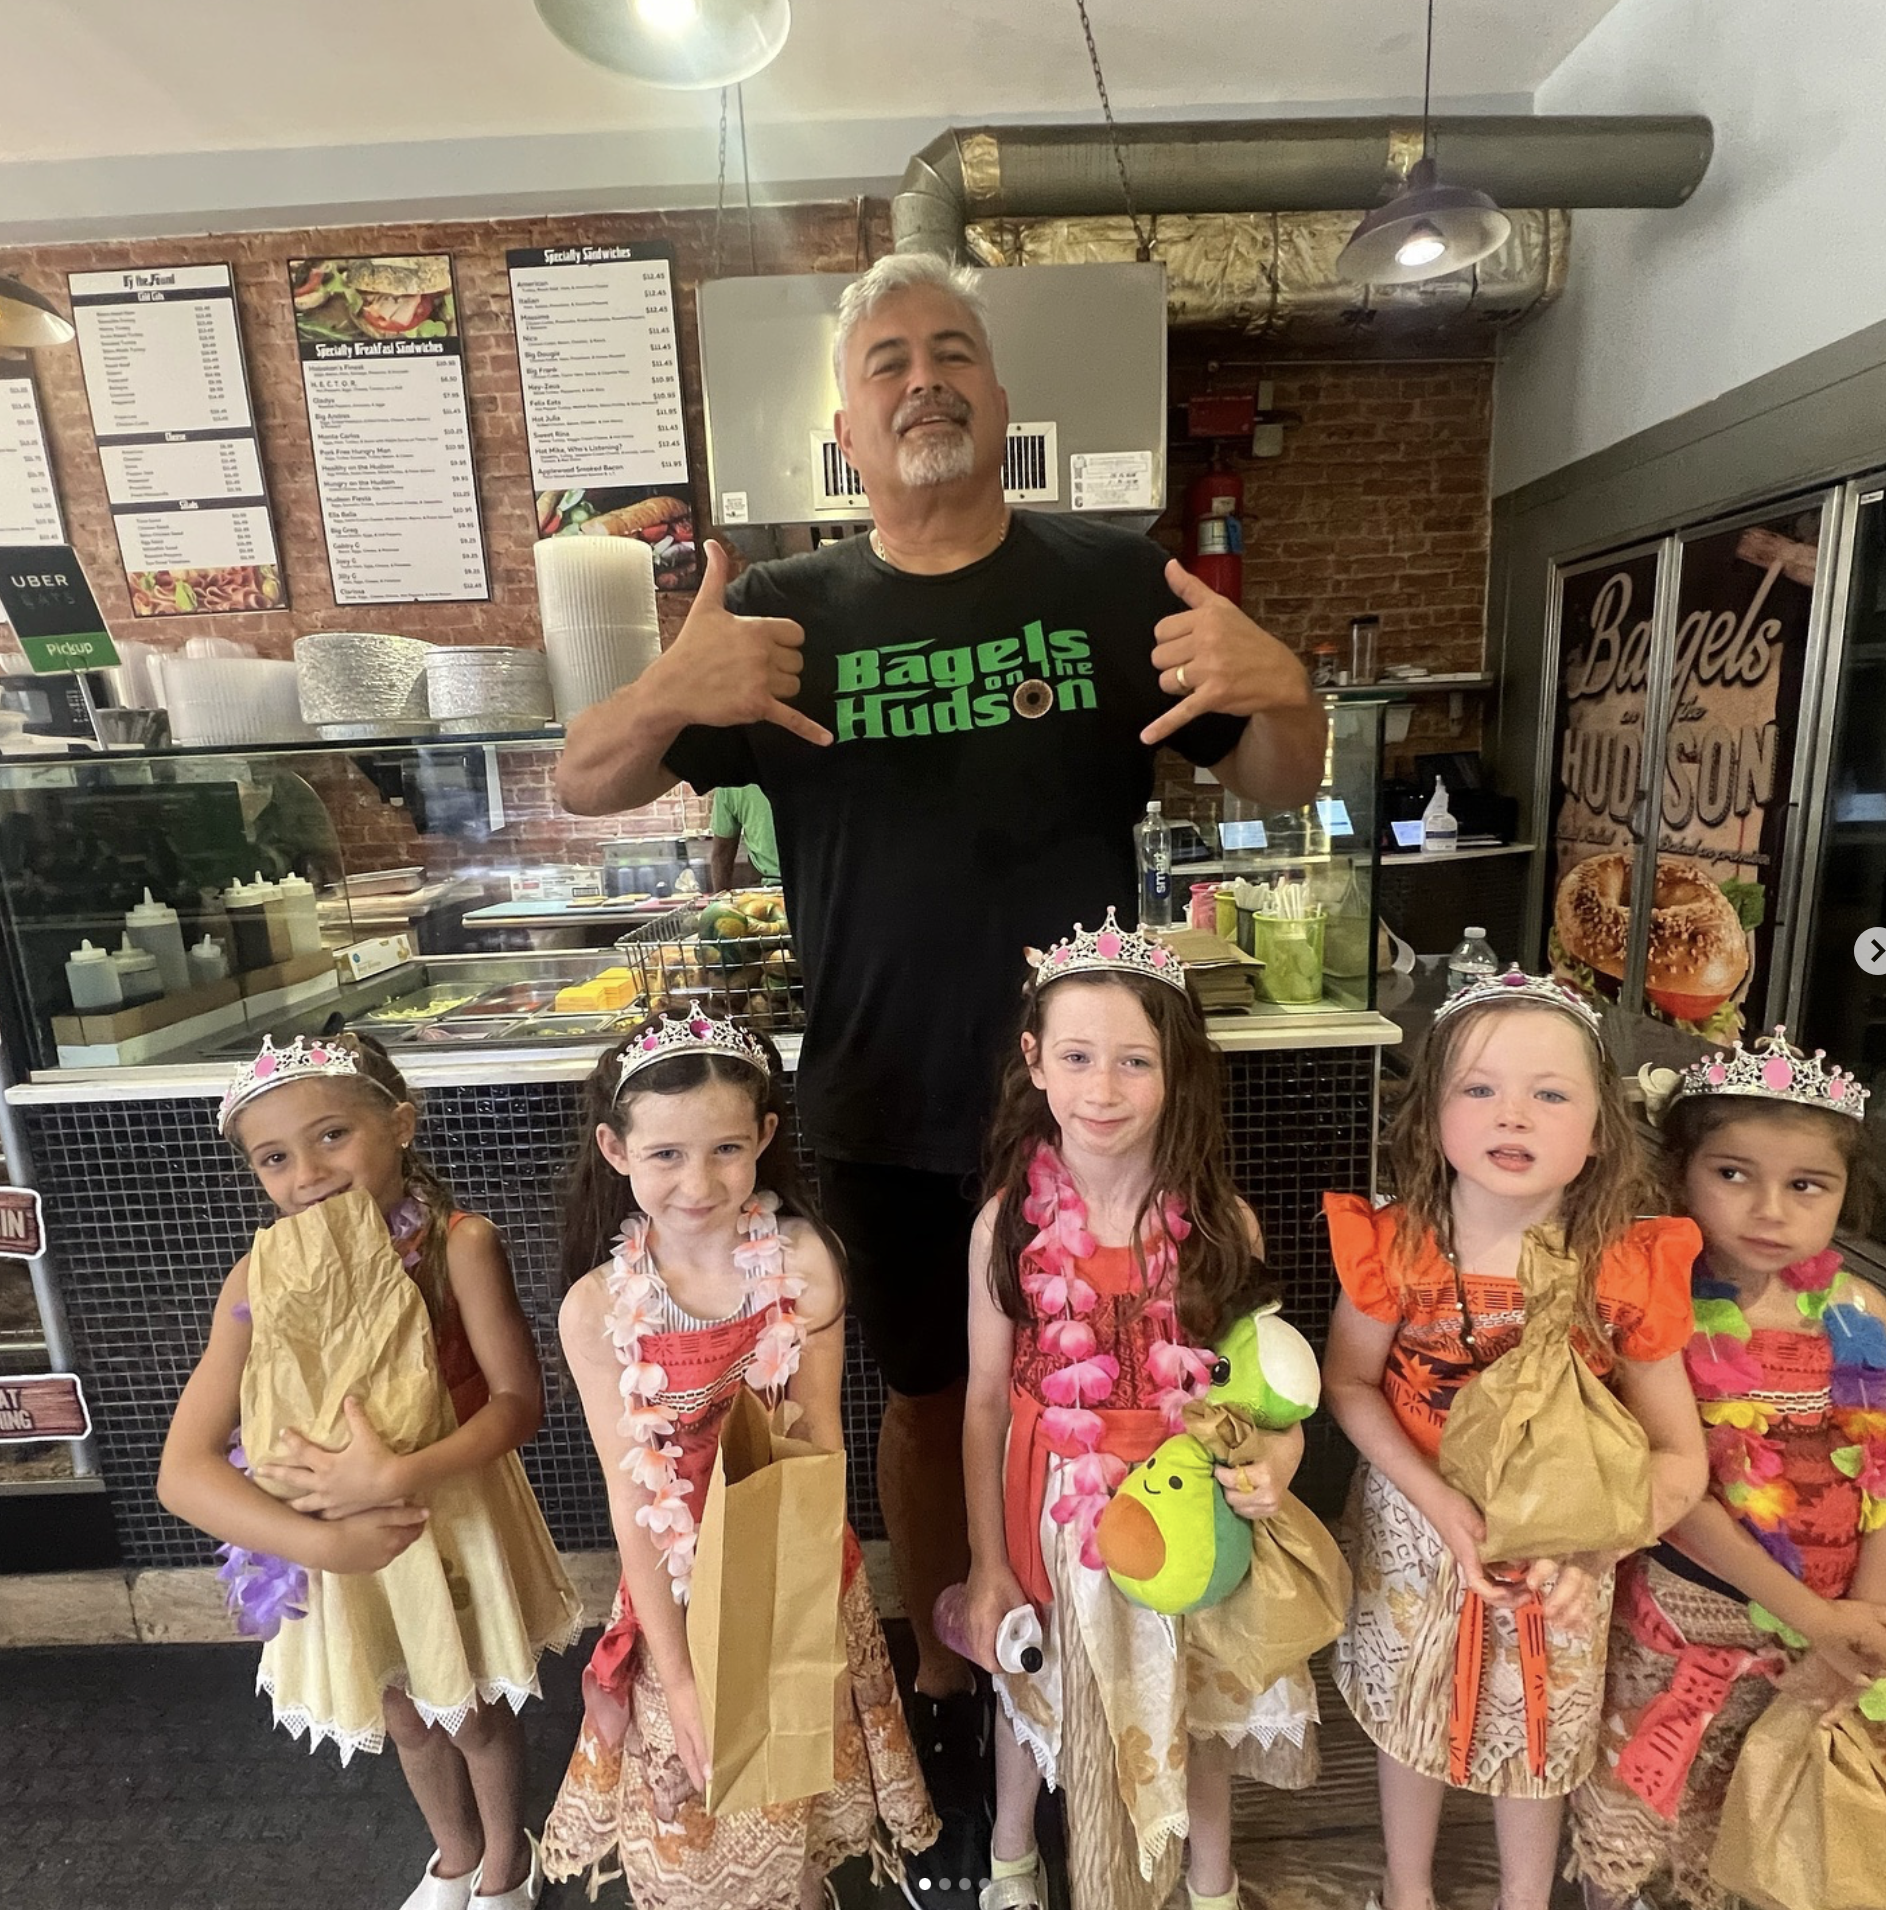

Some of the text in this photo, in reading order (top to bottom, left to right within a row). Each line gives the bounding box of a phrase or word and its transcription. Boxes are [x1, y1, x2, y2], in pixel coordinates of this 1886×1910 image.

[544, 246, 631, 265] Specialty Sandwiches
[643, 273, 665, 281] $12.45
[517, 280, 548, 288] American
[644, 289, 666, 298] $12.45
[646, 306, 668, 314] $12.45
[649, 327, 670, 335] $11.45
[315, 343, 352, 359] Specialty
[395, 340, 444, 354] Sandwiches
[524, 351, 537, 359] Big
[537, 350, 560, 358] Dougie
[652, 376, 674, 384] $10.95
[352, 448, 375, 456] Hungry
[589, 444, 622, 453] Listening?
[538, 467, 574, 475] Applewood
[576, 465, 602, 473] Smoked
[10, 574, 69, 588] UBER
[46, 642, 94, 657] Pickup
[834, 620, 1091, 693] Bagels
[985, 658, 1094, 691] on the
[1562, 722, 1779, 830] HUDSON
[1153, 851, 1166, 894] smart
